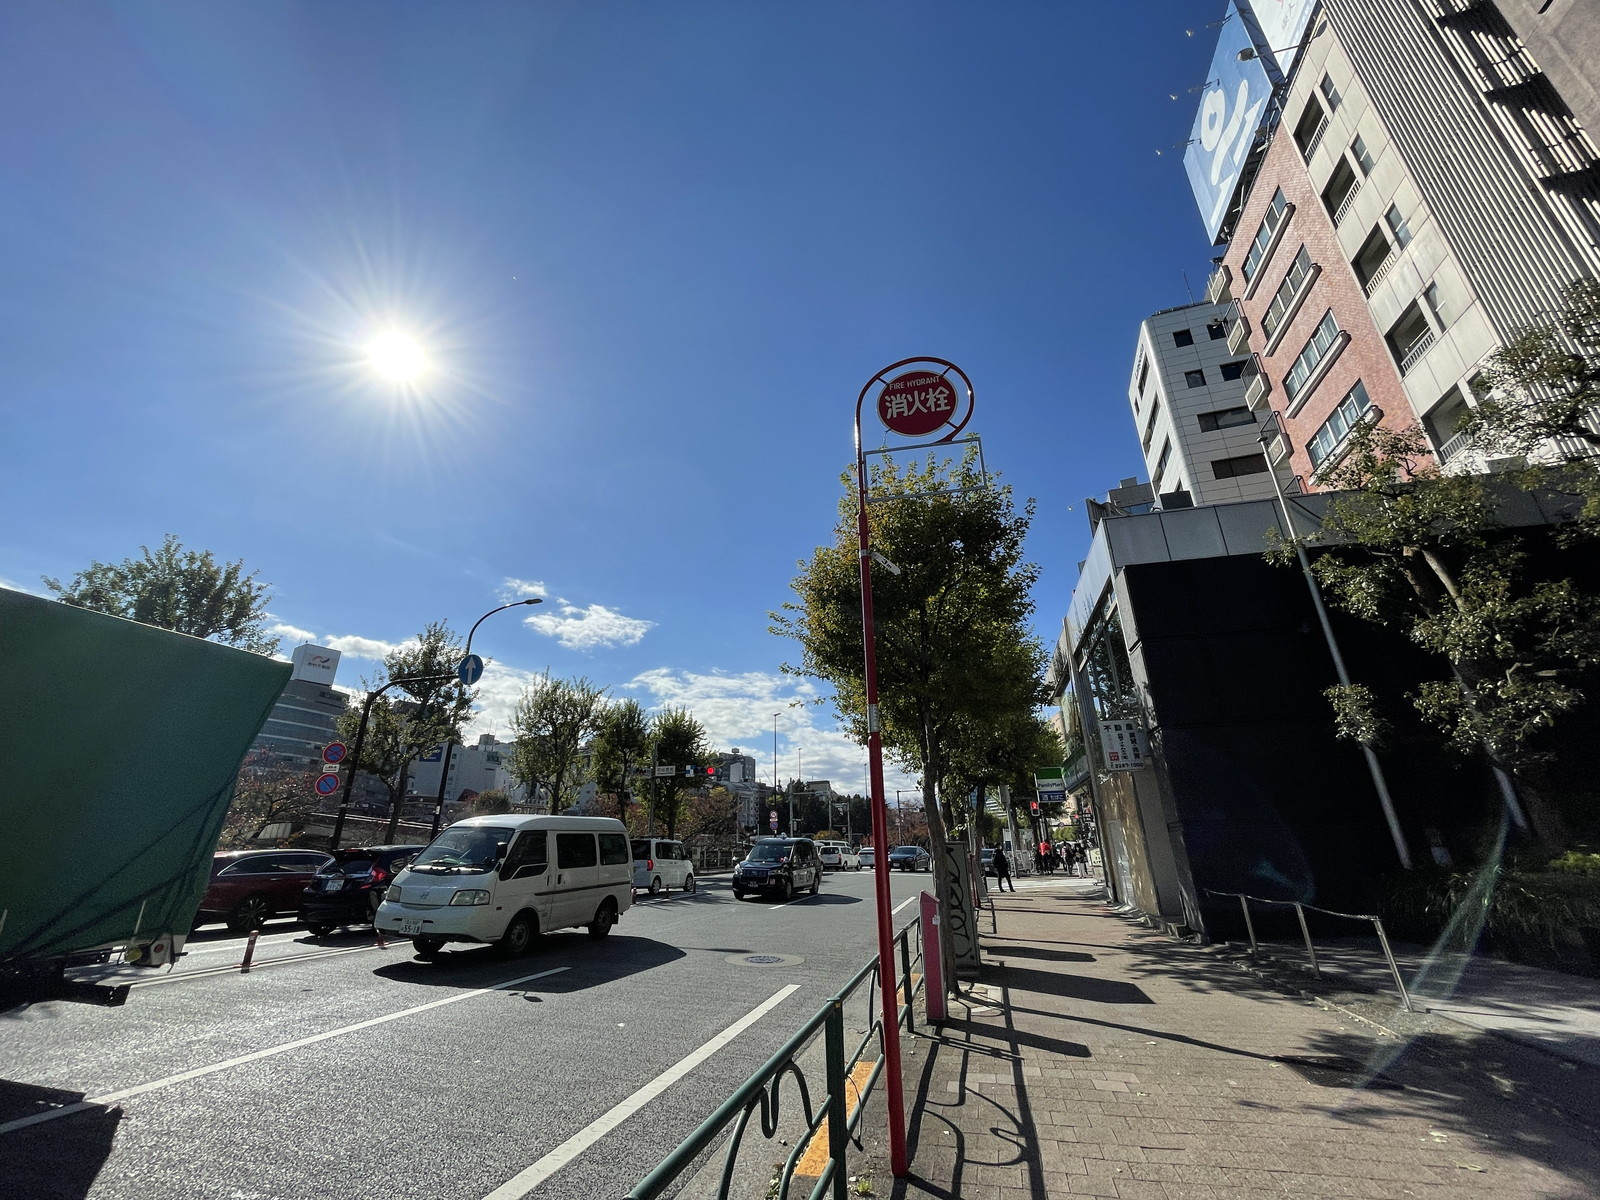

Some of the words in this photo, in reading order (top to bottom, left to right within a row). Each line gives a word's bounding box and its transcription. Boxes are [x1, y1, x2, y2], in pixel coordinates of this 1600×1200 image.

[889, 382, 905, 390] FIRE
[907, 376, 940, 387] HYDRANT
[884, 386, 951, 419] 消火栓
[403, 924, 420, 934] 55-18
